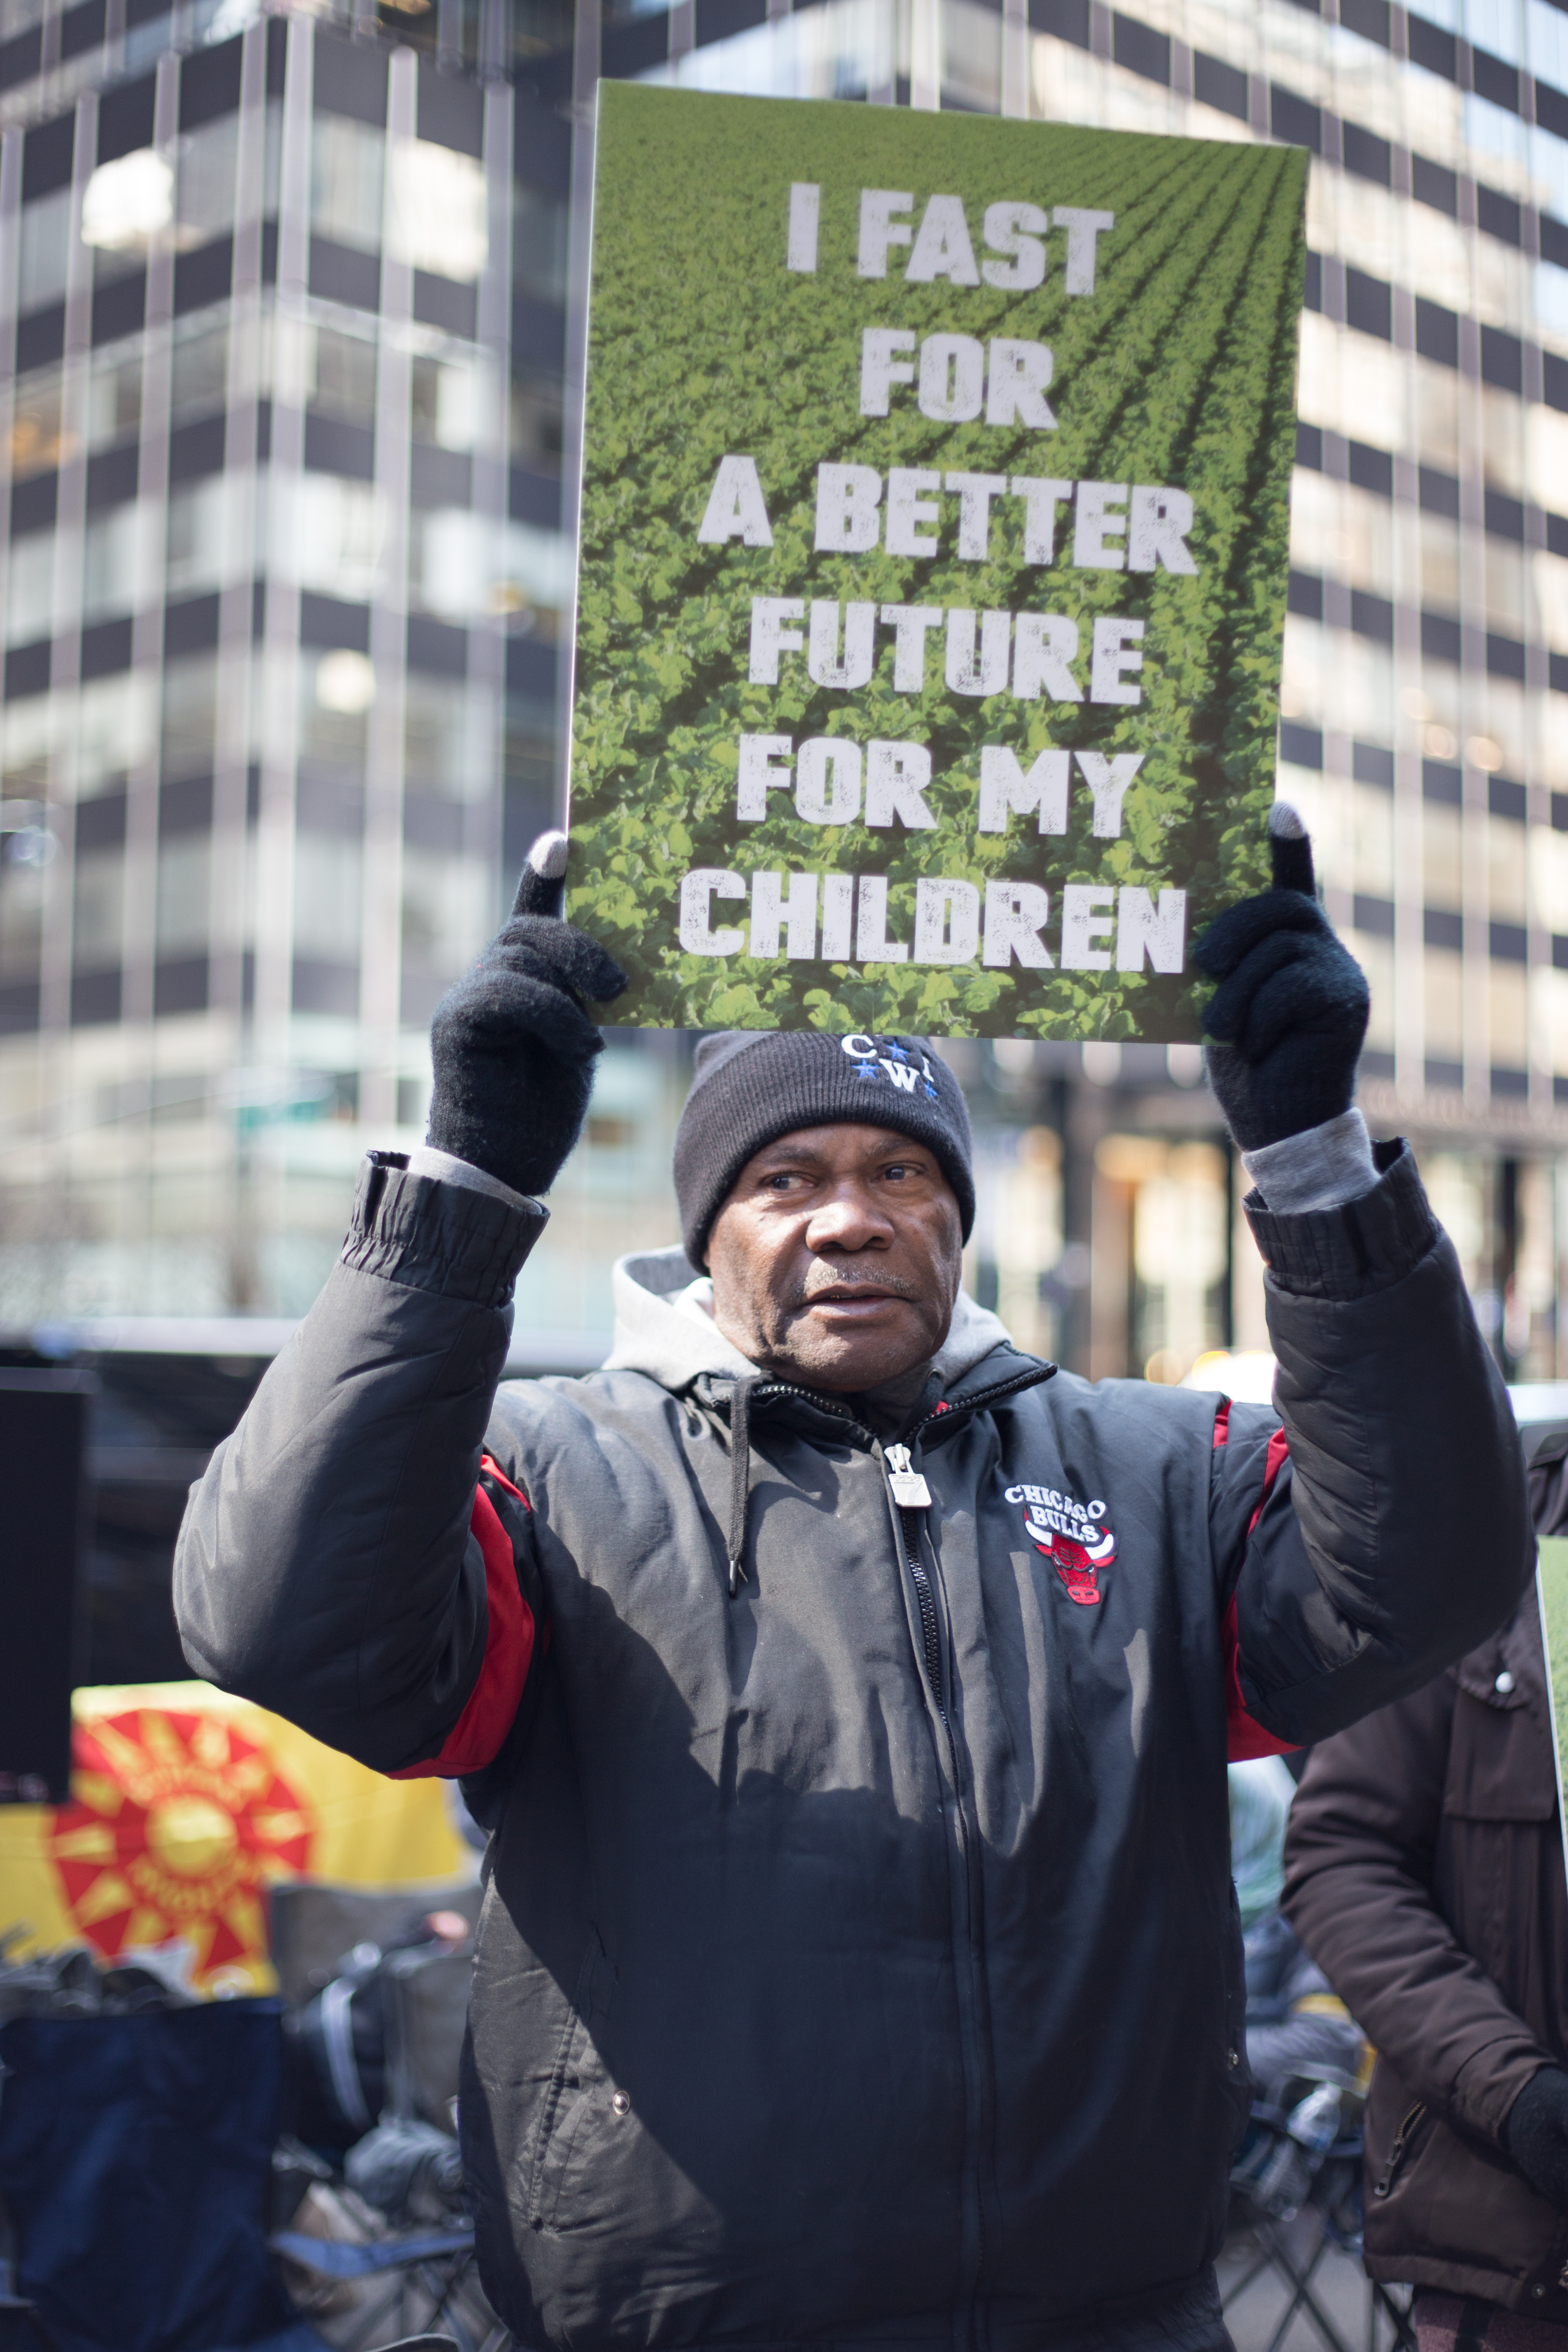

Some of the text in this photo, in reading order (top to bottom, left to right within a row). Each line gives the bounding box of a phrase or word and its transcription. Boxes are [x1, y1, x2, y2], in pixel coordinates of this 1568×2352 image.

[787, 182, 1114, 296] I FAST
[858, 327, 1059, 429] FOR
[696, 455, 1200, 577] A BETTER
[747, 596, 1146, 706] FUTURE
[736, 732, 1146, 839] FOR MY
[678, 867, 1187, 974] CHILDREN
[1004, 1484, 1106, 1523] CHICAGO
[1029, 1505, 1099, 1542] BULLS
